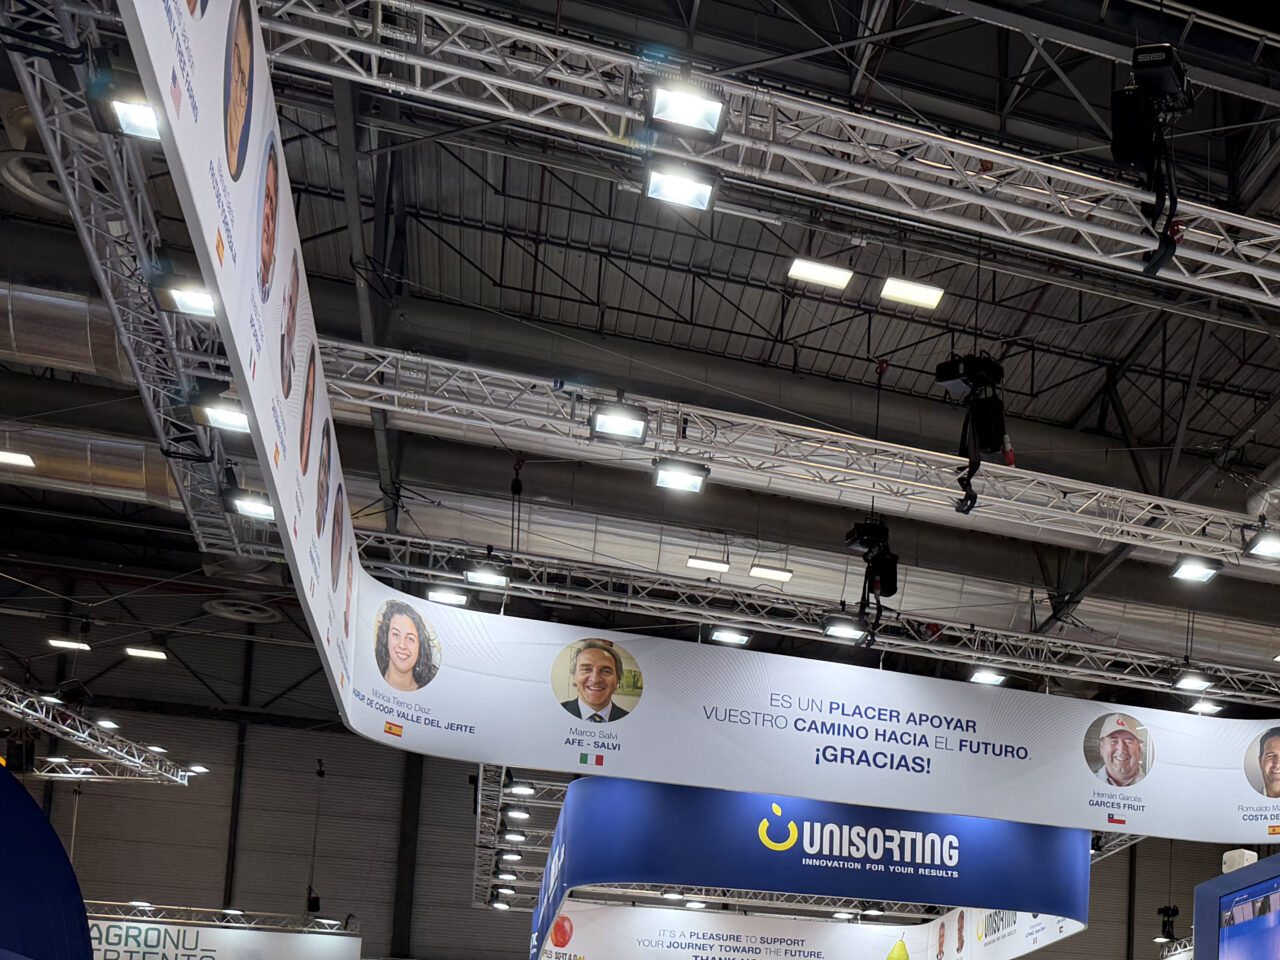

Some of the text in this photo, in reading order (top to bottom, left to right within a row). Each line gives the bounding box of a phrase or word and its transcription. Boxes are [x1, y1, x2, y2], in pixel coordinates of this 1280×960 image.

[366, 698, 375, 708] DE
[375, 701, 394, 716] COOP.
[397, 710, 422, 724] VALLE
[424, 717, 442, 729] DEL
[444, 722, 476, 734] JERTE
[770, 692, 977, 733] ES UN PLACER APOYAR
[569, 727, 618, 740] Marco Salvi
[703, 705, 1032, 760] VUESTRO CAMINO HACIA EL FUTURO.
[564, 737, 584, 747] AFE
[593, 741, 621, 751] SALVI
[815, 745, 931, 774] ¡GRACIAS!
[1088, 799, 1121, 809] GARCES
[802, 821, 959, 867] UNISORTING
[802, 857, 959, 878] INNOVATION FOR YOUR RESULTS
[636, 938, 664, 948] YOUR
[666, 941, 715, 952] JOURNEY
[718, 944, 762, 955] TOWARD
[764, 948, 782, 956] THE
[658, 929, 676, 939] IT'S
[689, 931, 742, 942] PLEASURE
[745, 935, 757, 944] TO
[759, 936, 805, 947] SUPPORT
[555, 951, 567, 960] SORT
